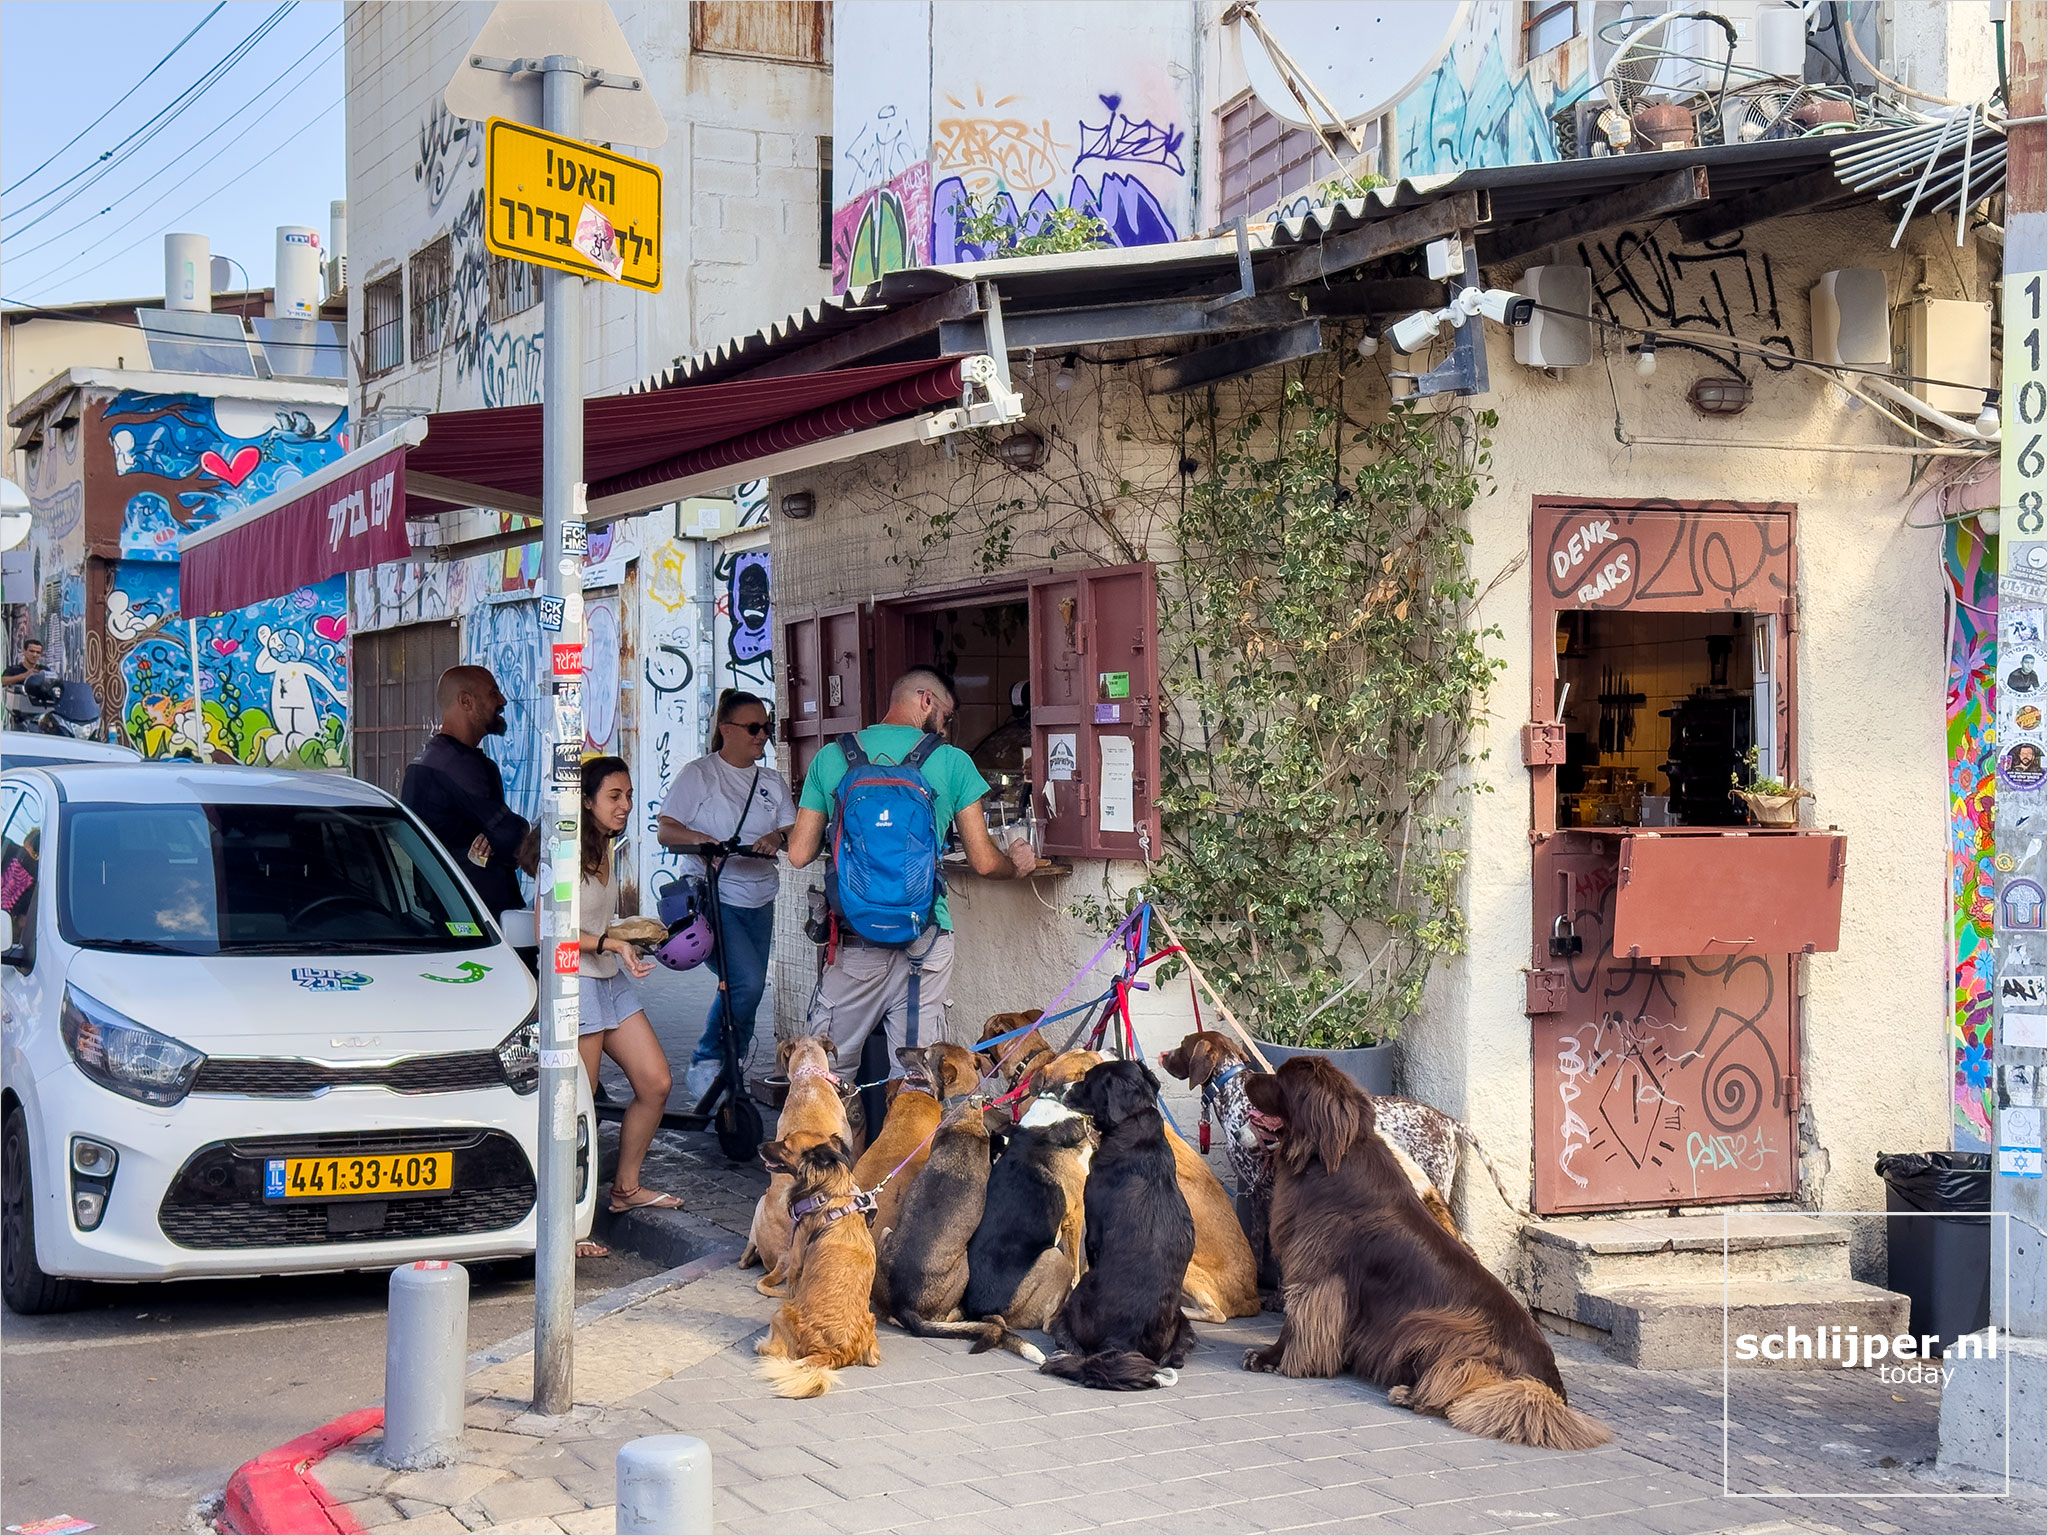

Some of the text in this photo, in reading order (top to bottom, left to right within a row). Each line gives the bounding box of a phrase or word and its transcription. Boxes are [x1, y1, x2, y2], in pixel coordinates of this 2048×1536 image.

[546, 148, 616, 206] האט!
[499, 197, 572, 248] בדרך
[2017, 275, 2048, 535] 11068
[562, 526, 588, 540] FCK
[562, 538, 588, 551] HMS
[1553, 519, 1619, 579] DENK
